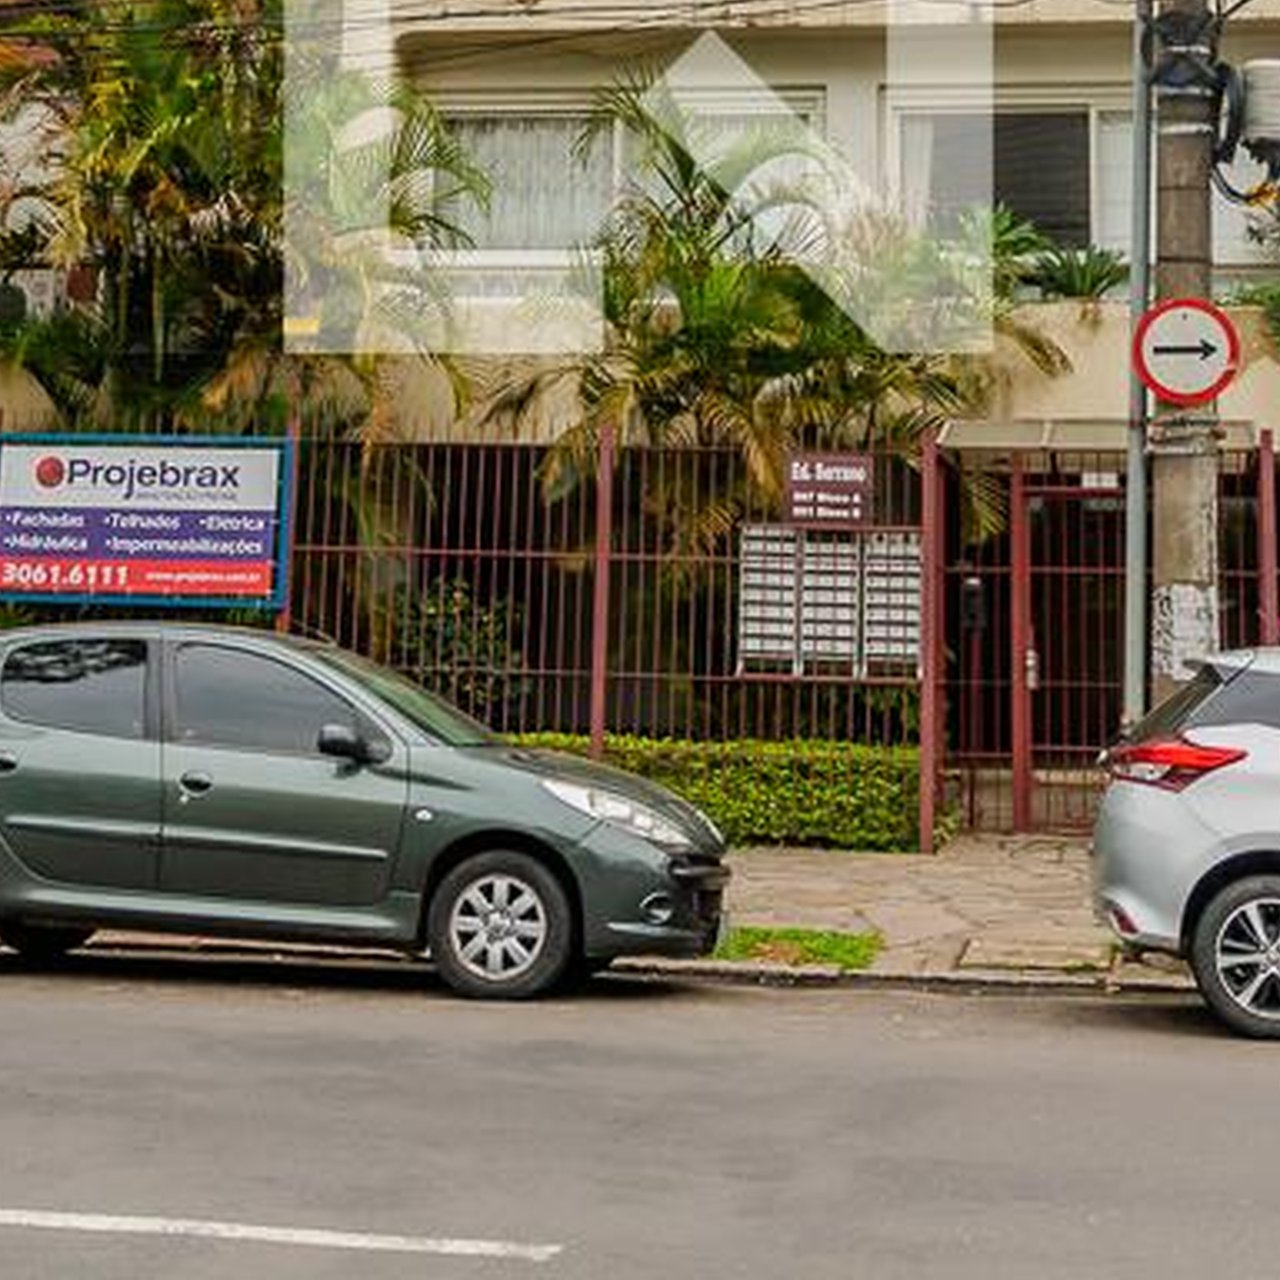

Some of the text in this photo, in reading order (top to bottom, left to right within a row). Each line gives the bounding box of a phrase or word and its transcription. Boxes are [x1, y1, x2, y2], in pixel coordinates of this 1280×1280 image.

[67, 458, 240, 499] Projebrax
[10, 512, 85, 529] Fachadas
[110, 513, 180, 530] Telhados
[110, 536, 263, 556] Impermeabilizações
[1, 562, 129, 587] 3061.6111
